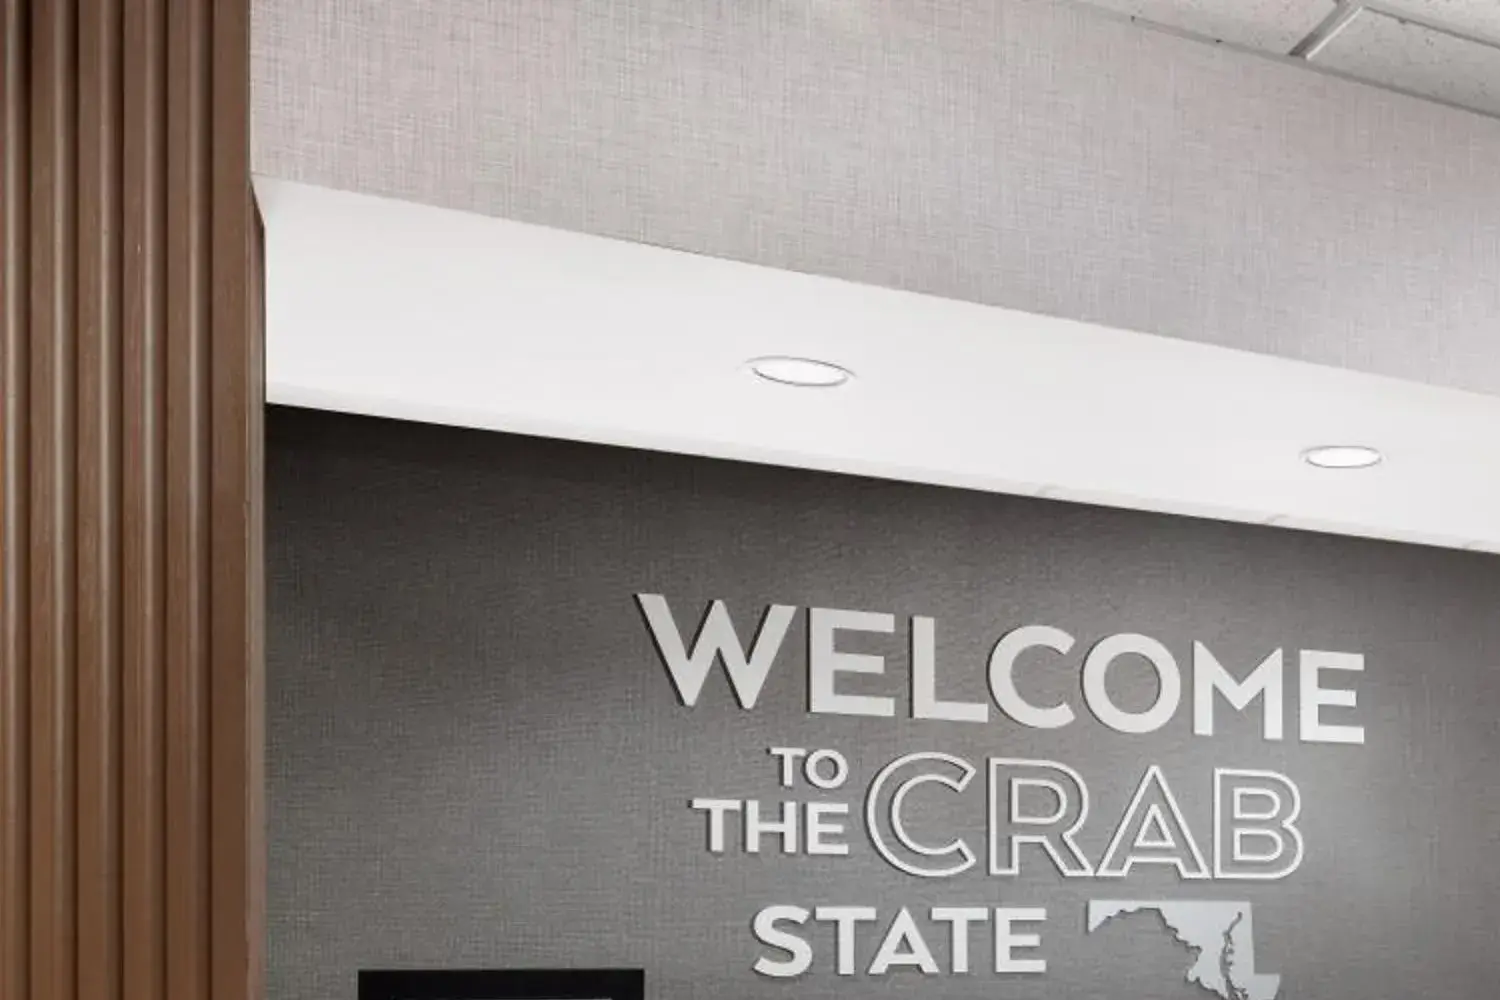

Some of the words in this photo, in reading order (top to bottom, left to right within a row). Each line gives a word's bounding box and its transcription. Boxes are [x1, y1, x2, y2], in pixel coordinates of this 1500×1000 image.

[636, 592, 1366, 745] WELCOME
[691, 798, 850, 856] THE
[866, 751, 1304, 880] CRAB
[769, 746, 850, 790] TO
[751, 904, 1048, 978] STATE
